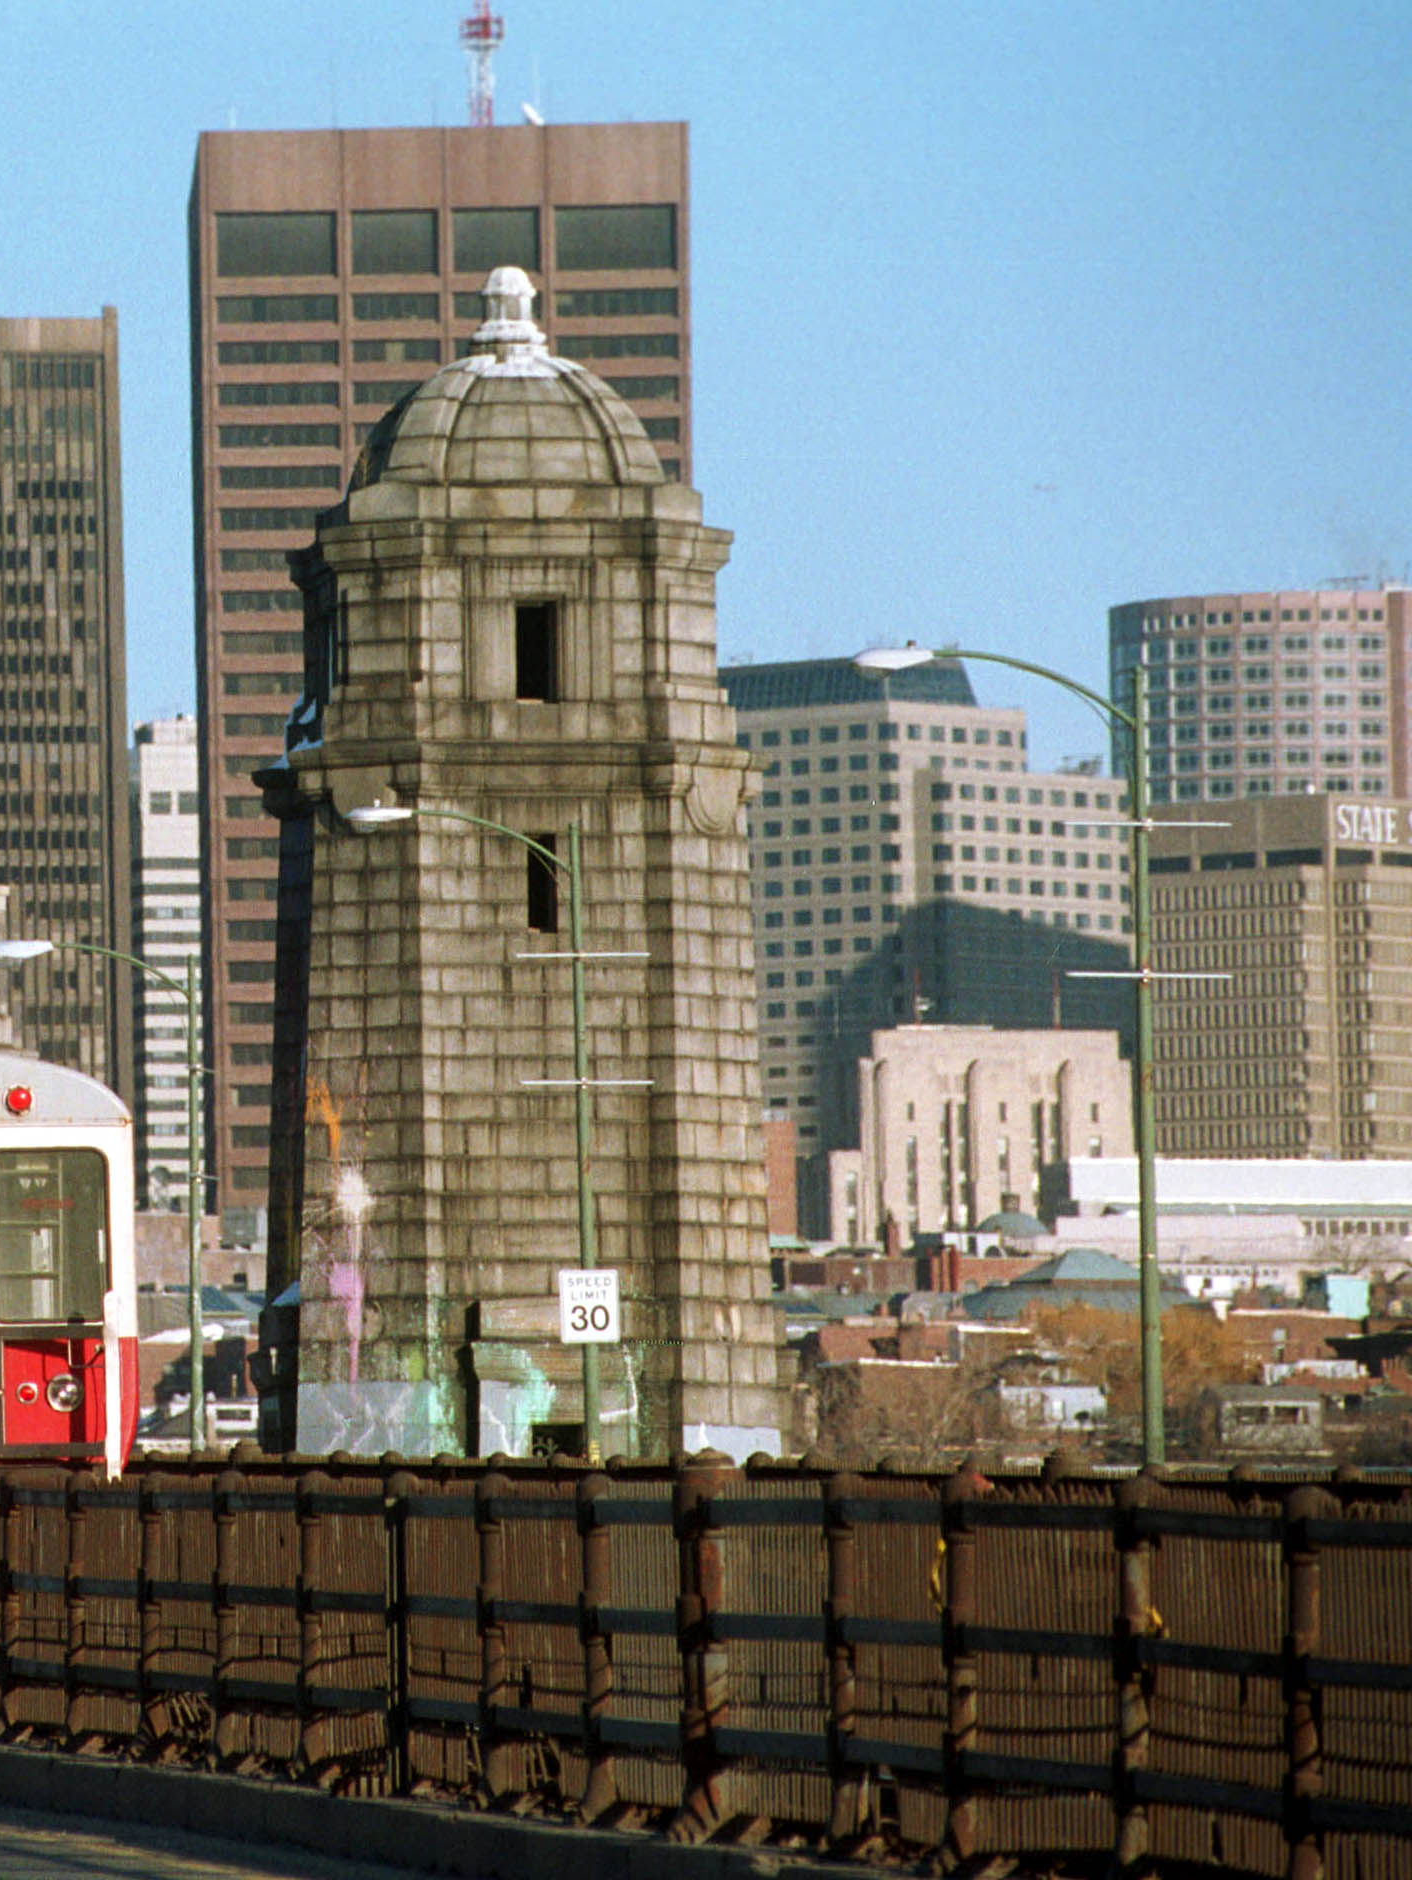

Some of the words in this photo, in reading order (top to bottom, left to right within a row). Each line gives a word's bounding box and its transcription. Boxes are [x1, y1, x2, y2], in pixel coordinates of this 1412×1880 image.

[1337, 804, 1398, 843] STATE
[567, 1277, 612, 1288] SPEED
[570, 1290, 607, 1301] LIMIT
[571, 1304, 610, 1332] 30
